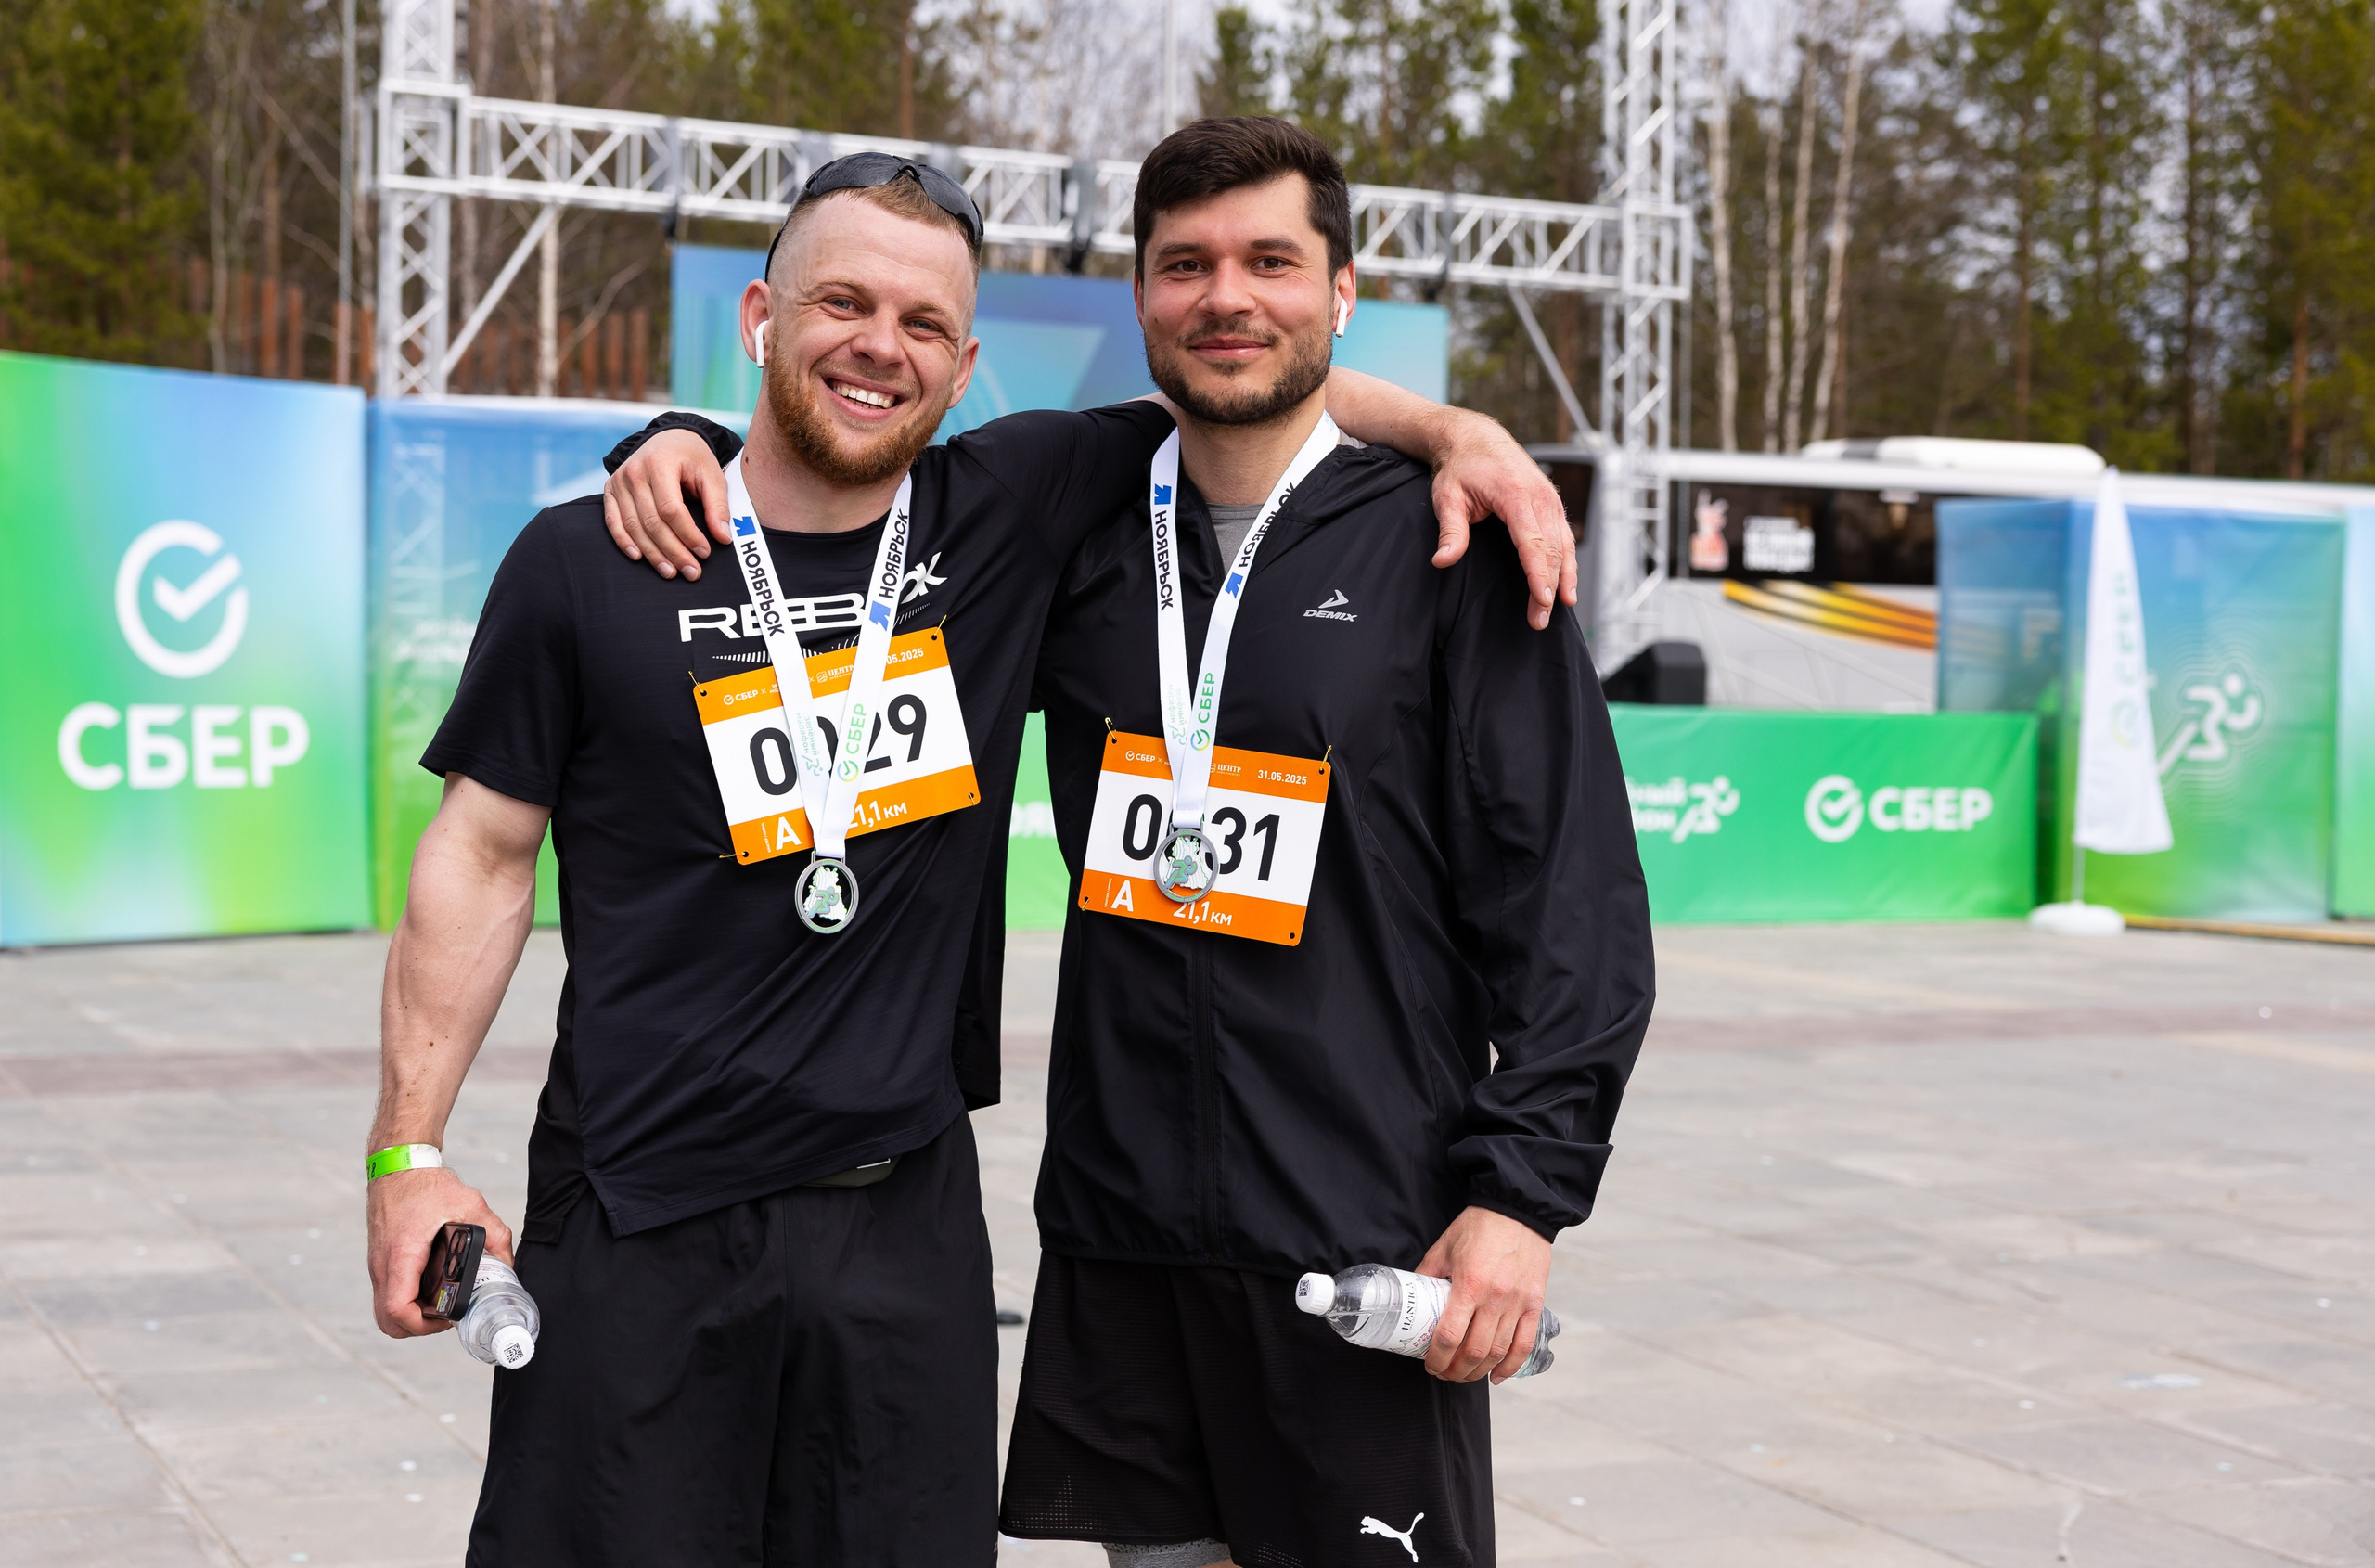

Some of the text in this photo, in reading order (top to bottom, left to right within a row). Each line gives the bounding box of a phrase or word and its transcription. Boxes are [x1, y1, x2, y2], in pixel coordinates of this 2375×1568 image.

[879, 508, 909, 599] НОЯБРЬСК
[1154, 509, 1174, 612] НОЯБРЬСК
[740, 540, 785, 638] НОЯБРЬСК
[1303, 609, 1358, 622] DEMIX
[828, 664, 856, 677] ЦЕНТР
[886, 648, 925, 665] 05.2025
[735, 689, 759, 701] СБЕР
[1198, 672, 1215, 724] СБЕР
[57, 700, 311, 791] СБЕР
[845, 703, 867, 755] СБЕР
[1136, 752, 1156, 763] СБЕР
[1217, 764, 1242, 774] ЦЕНТР
[1257, 769, 1308, 786] 31.05.2025
[1868, 785, 1995, 833] СБЕР
[1122, 793, 1281, 882] 031
